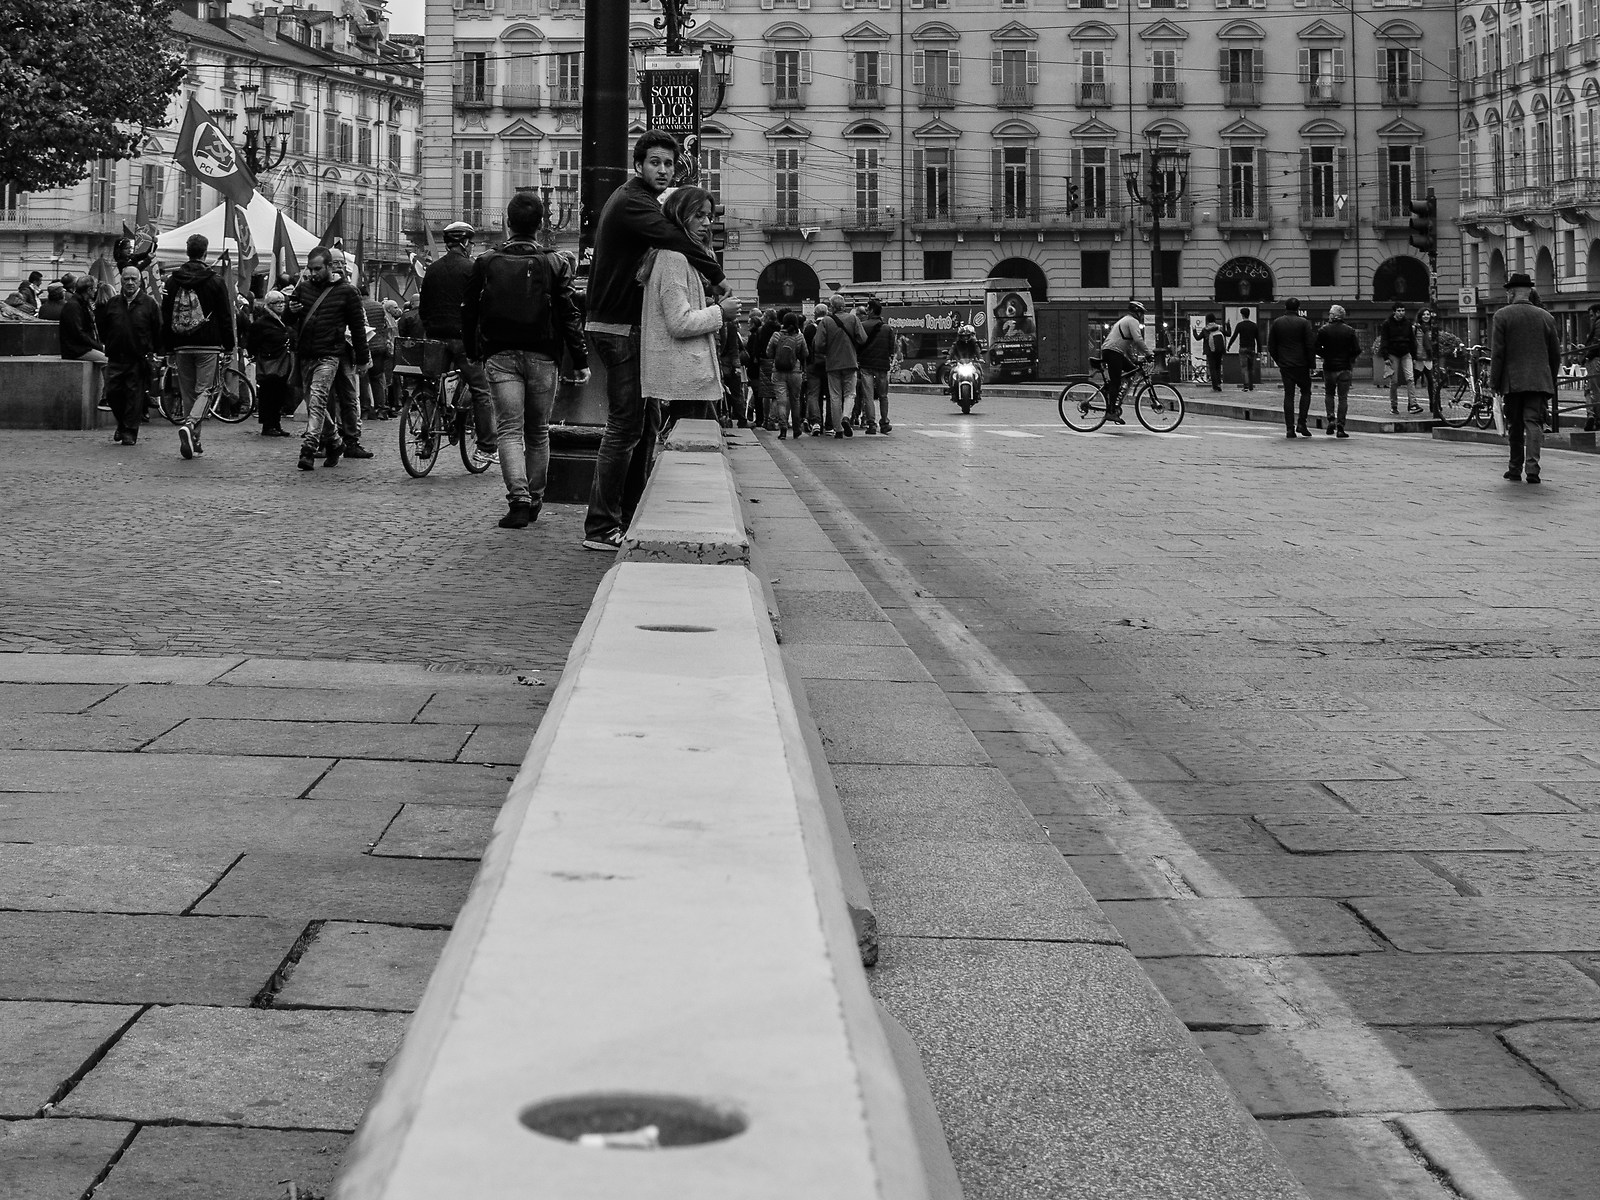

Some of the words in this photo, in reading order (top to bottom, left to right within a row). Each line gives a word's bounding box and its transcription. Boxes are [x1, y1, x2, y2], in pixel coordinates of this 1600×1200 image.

[651, 85, 693, 96] SOTTO
[652, 103, 694, 117] LUCE
[651, 116, 693, 124] GIOIELLI
[200, 162, 213, 174] PCI
[925, 313, 952, 329] Torino
